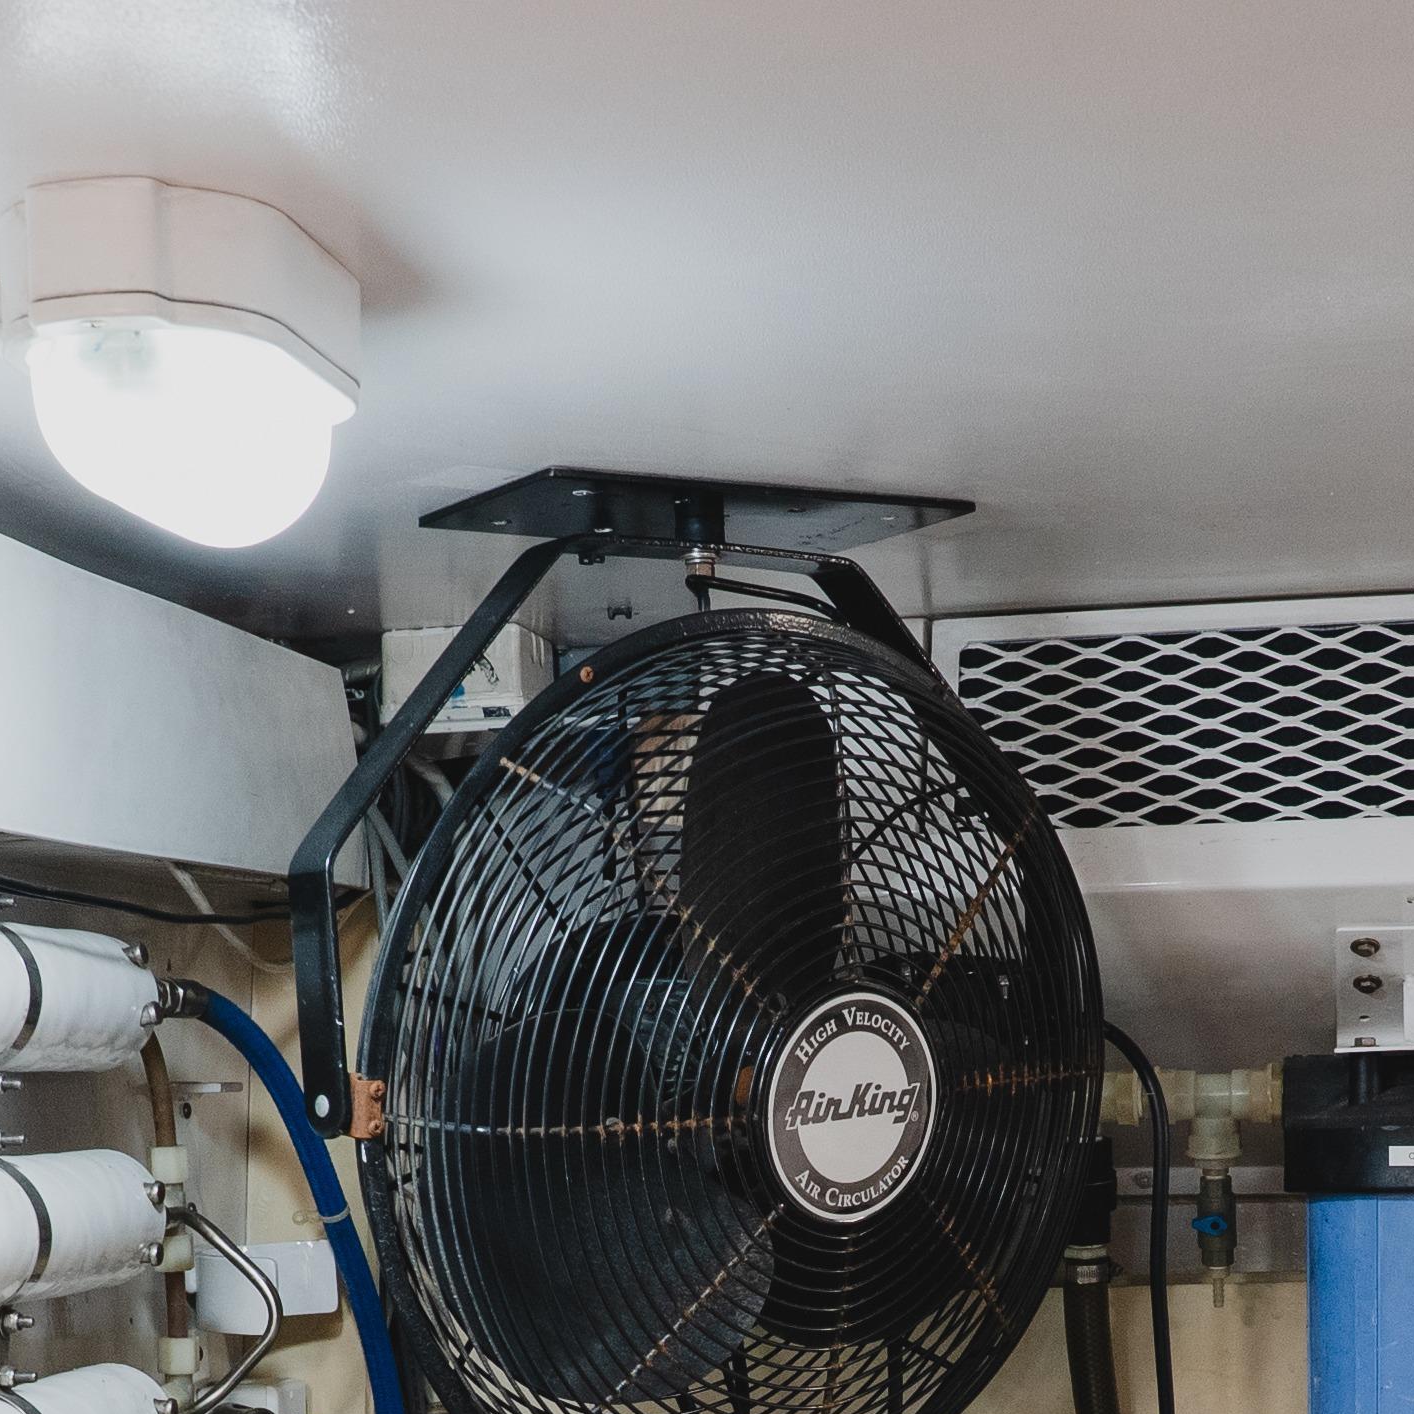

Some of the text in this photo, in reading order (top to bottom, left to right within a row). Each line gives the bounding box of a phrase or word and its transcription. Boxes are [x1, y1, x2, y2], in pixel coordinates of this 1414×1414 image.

[794, 1006, 911, 1065] HIGH VELOCITY
[795, 1156, 909, 1208] AIR CIRCULATOR
